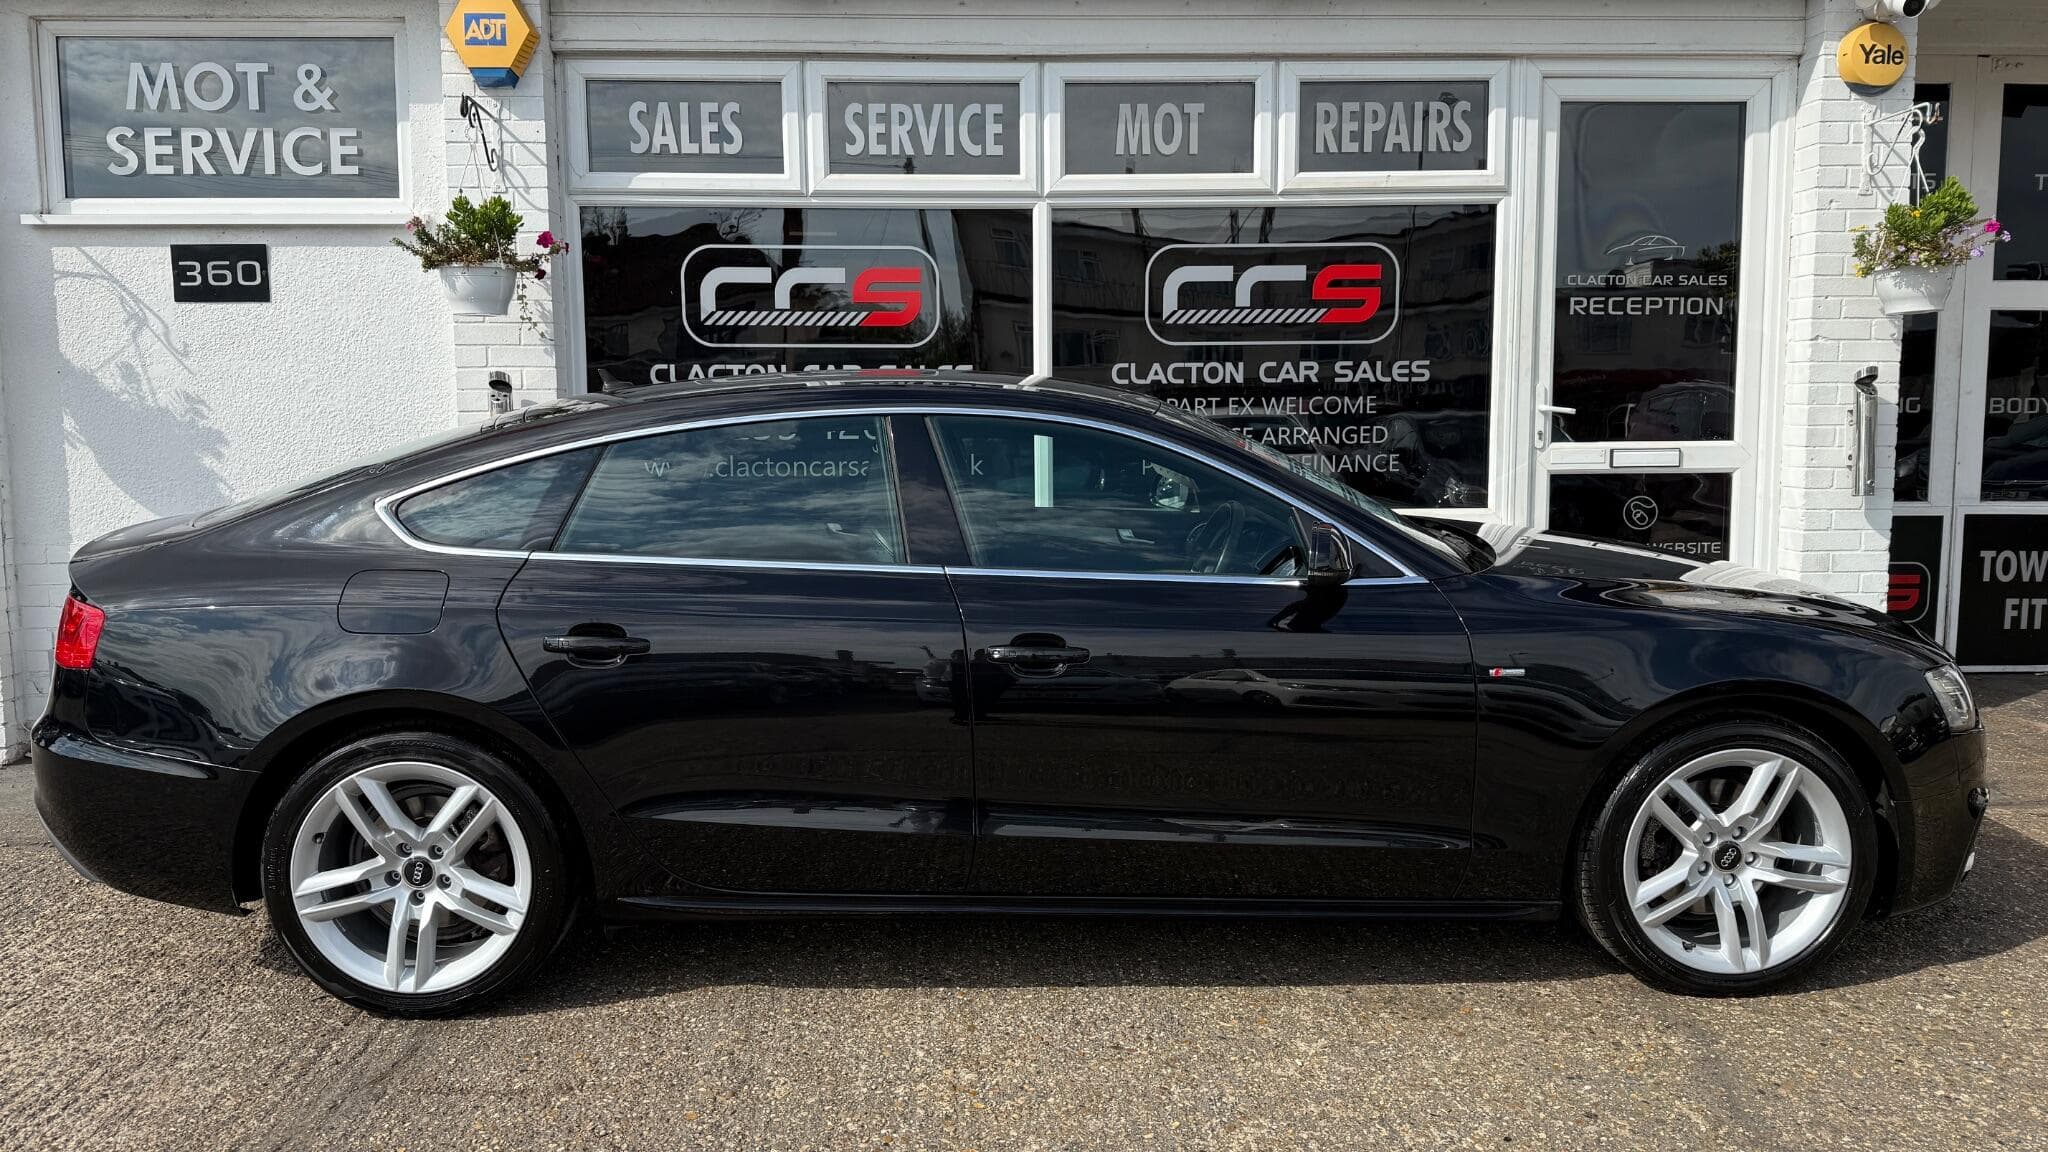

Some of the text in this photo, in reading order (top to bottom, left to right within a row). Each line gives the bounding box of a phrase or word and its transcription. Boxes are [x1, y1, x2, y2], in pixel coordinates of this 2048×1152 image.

[465, 19, 506, 40] ADT
[1859, 43, 1905, 66] Yale
[126, 62, 336, 112] MOT &
[629, 101, 744, 156] SALES
[845, 102, 1004, 157] SERVICE
[1115, 102, 1205, 156] MOT
[1315, 101, 1472, 154] REPAIRS
[106, 127, 360, 177] SERVICE
[179, 260, 262, 287] 360
[1567, 274, 1728, 286] CLACTON CAR SALES
[1569, 296, 1724, 316] RECEPTION
[1111, 360, 1431, 385] CLACTON CAR SALES
[1228, 397, 1255, 416] EX
[1261, 396, 1377, 416] WELCOME
[1262, 426, 1388, 446] ARRANGED
[1302, 453, 1400, 473] FINANCE
[1646, 541, 1722, 554] EBSITE
